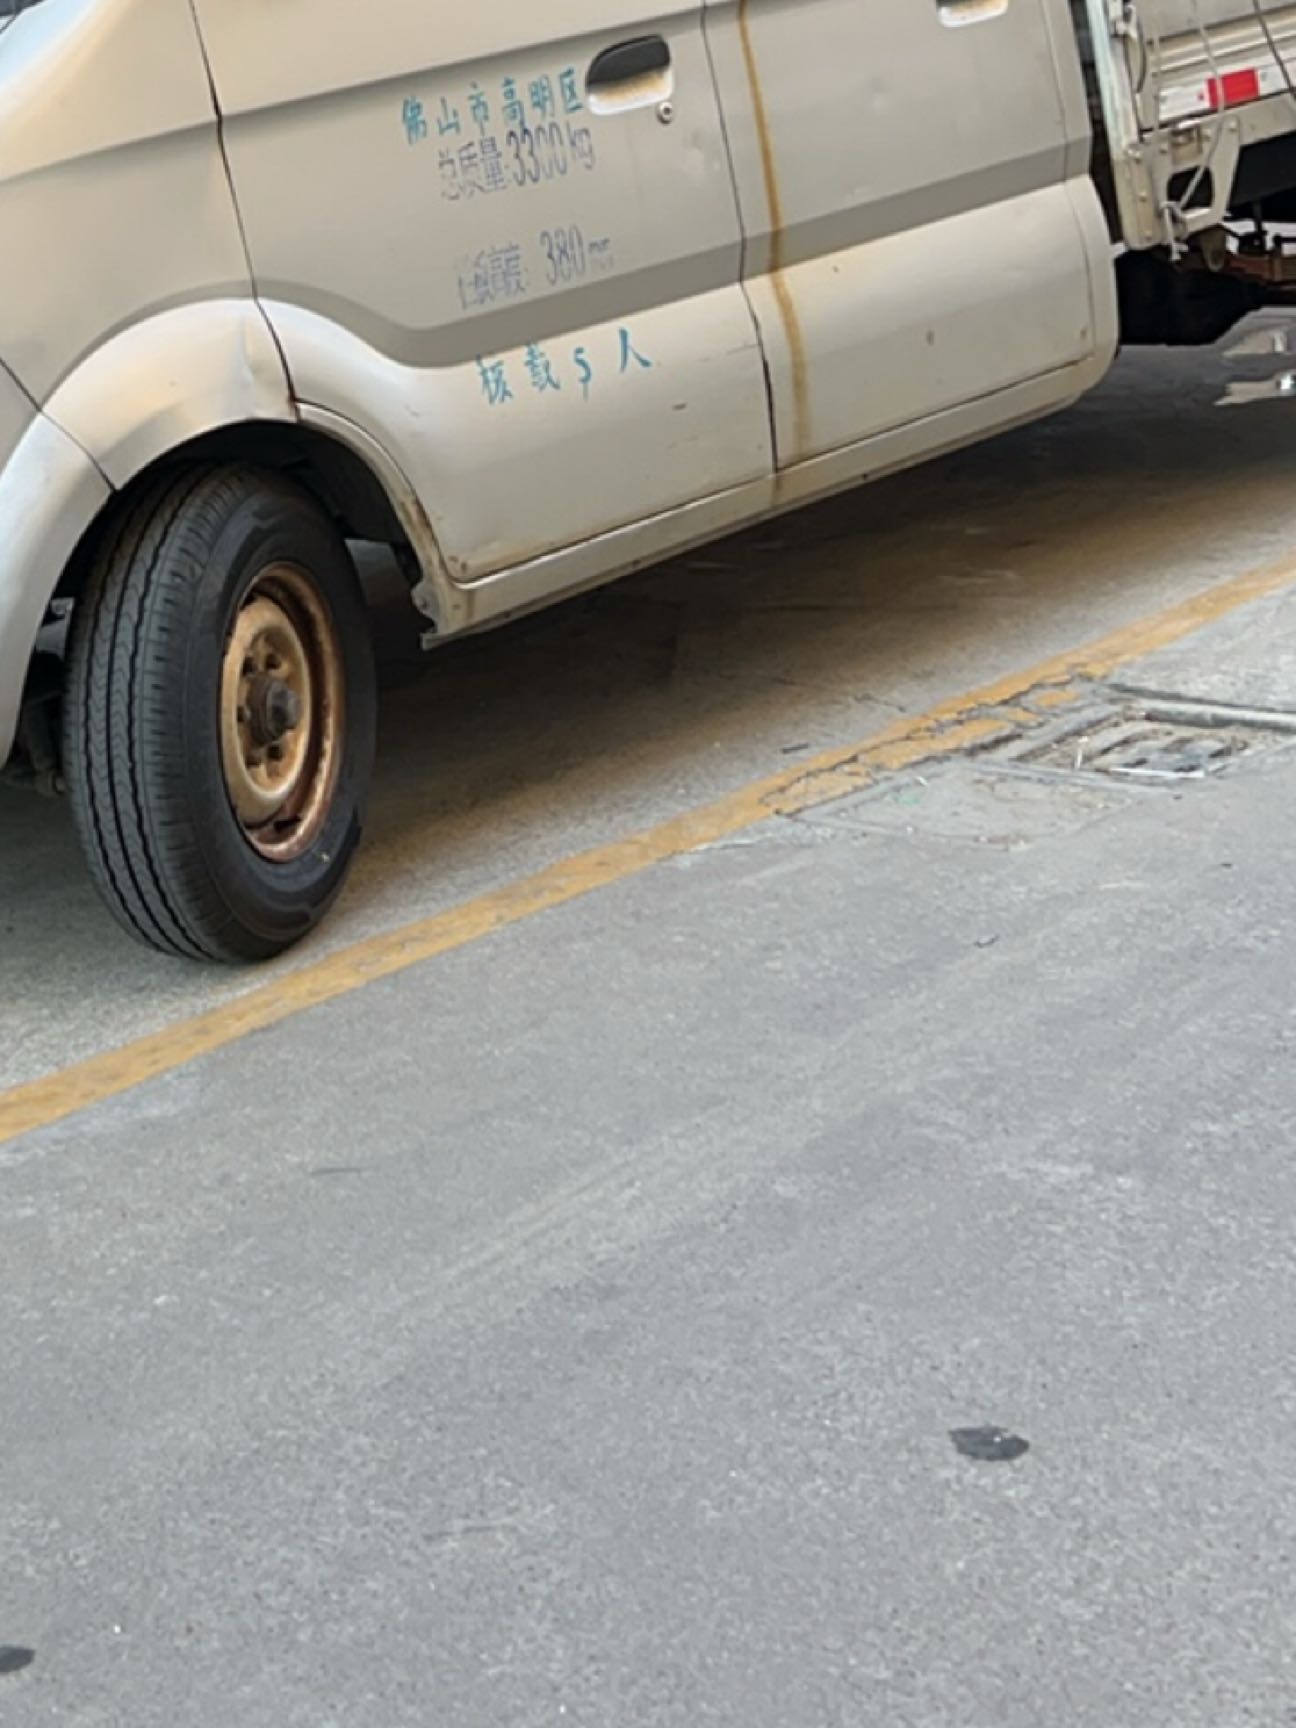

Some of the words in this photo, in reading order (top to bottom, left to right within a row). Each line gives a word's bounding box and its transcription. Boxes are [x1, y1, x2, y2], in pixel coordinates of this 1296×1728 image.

[402, 66, 585, 145] 佛山市高明区
